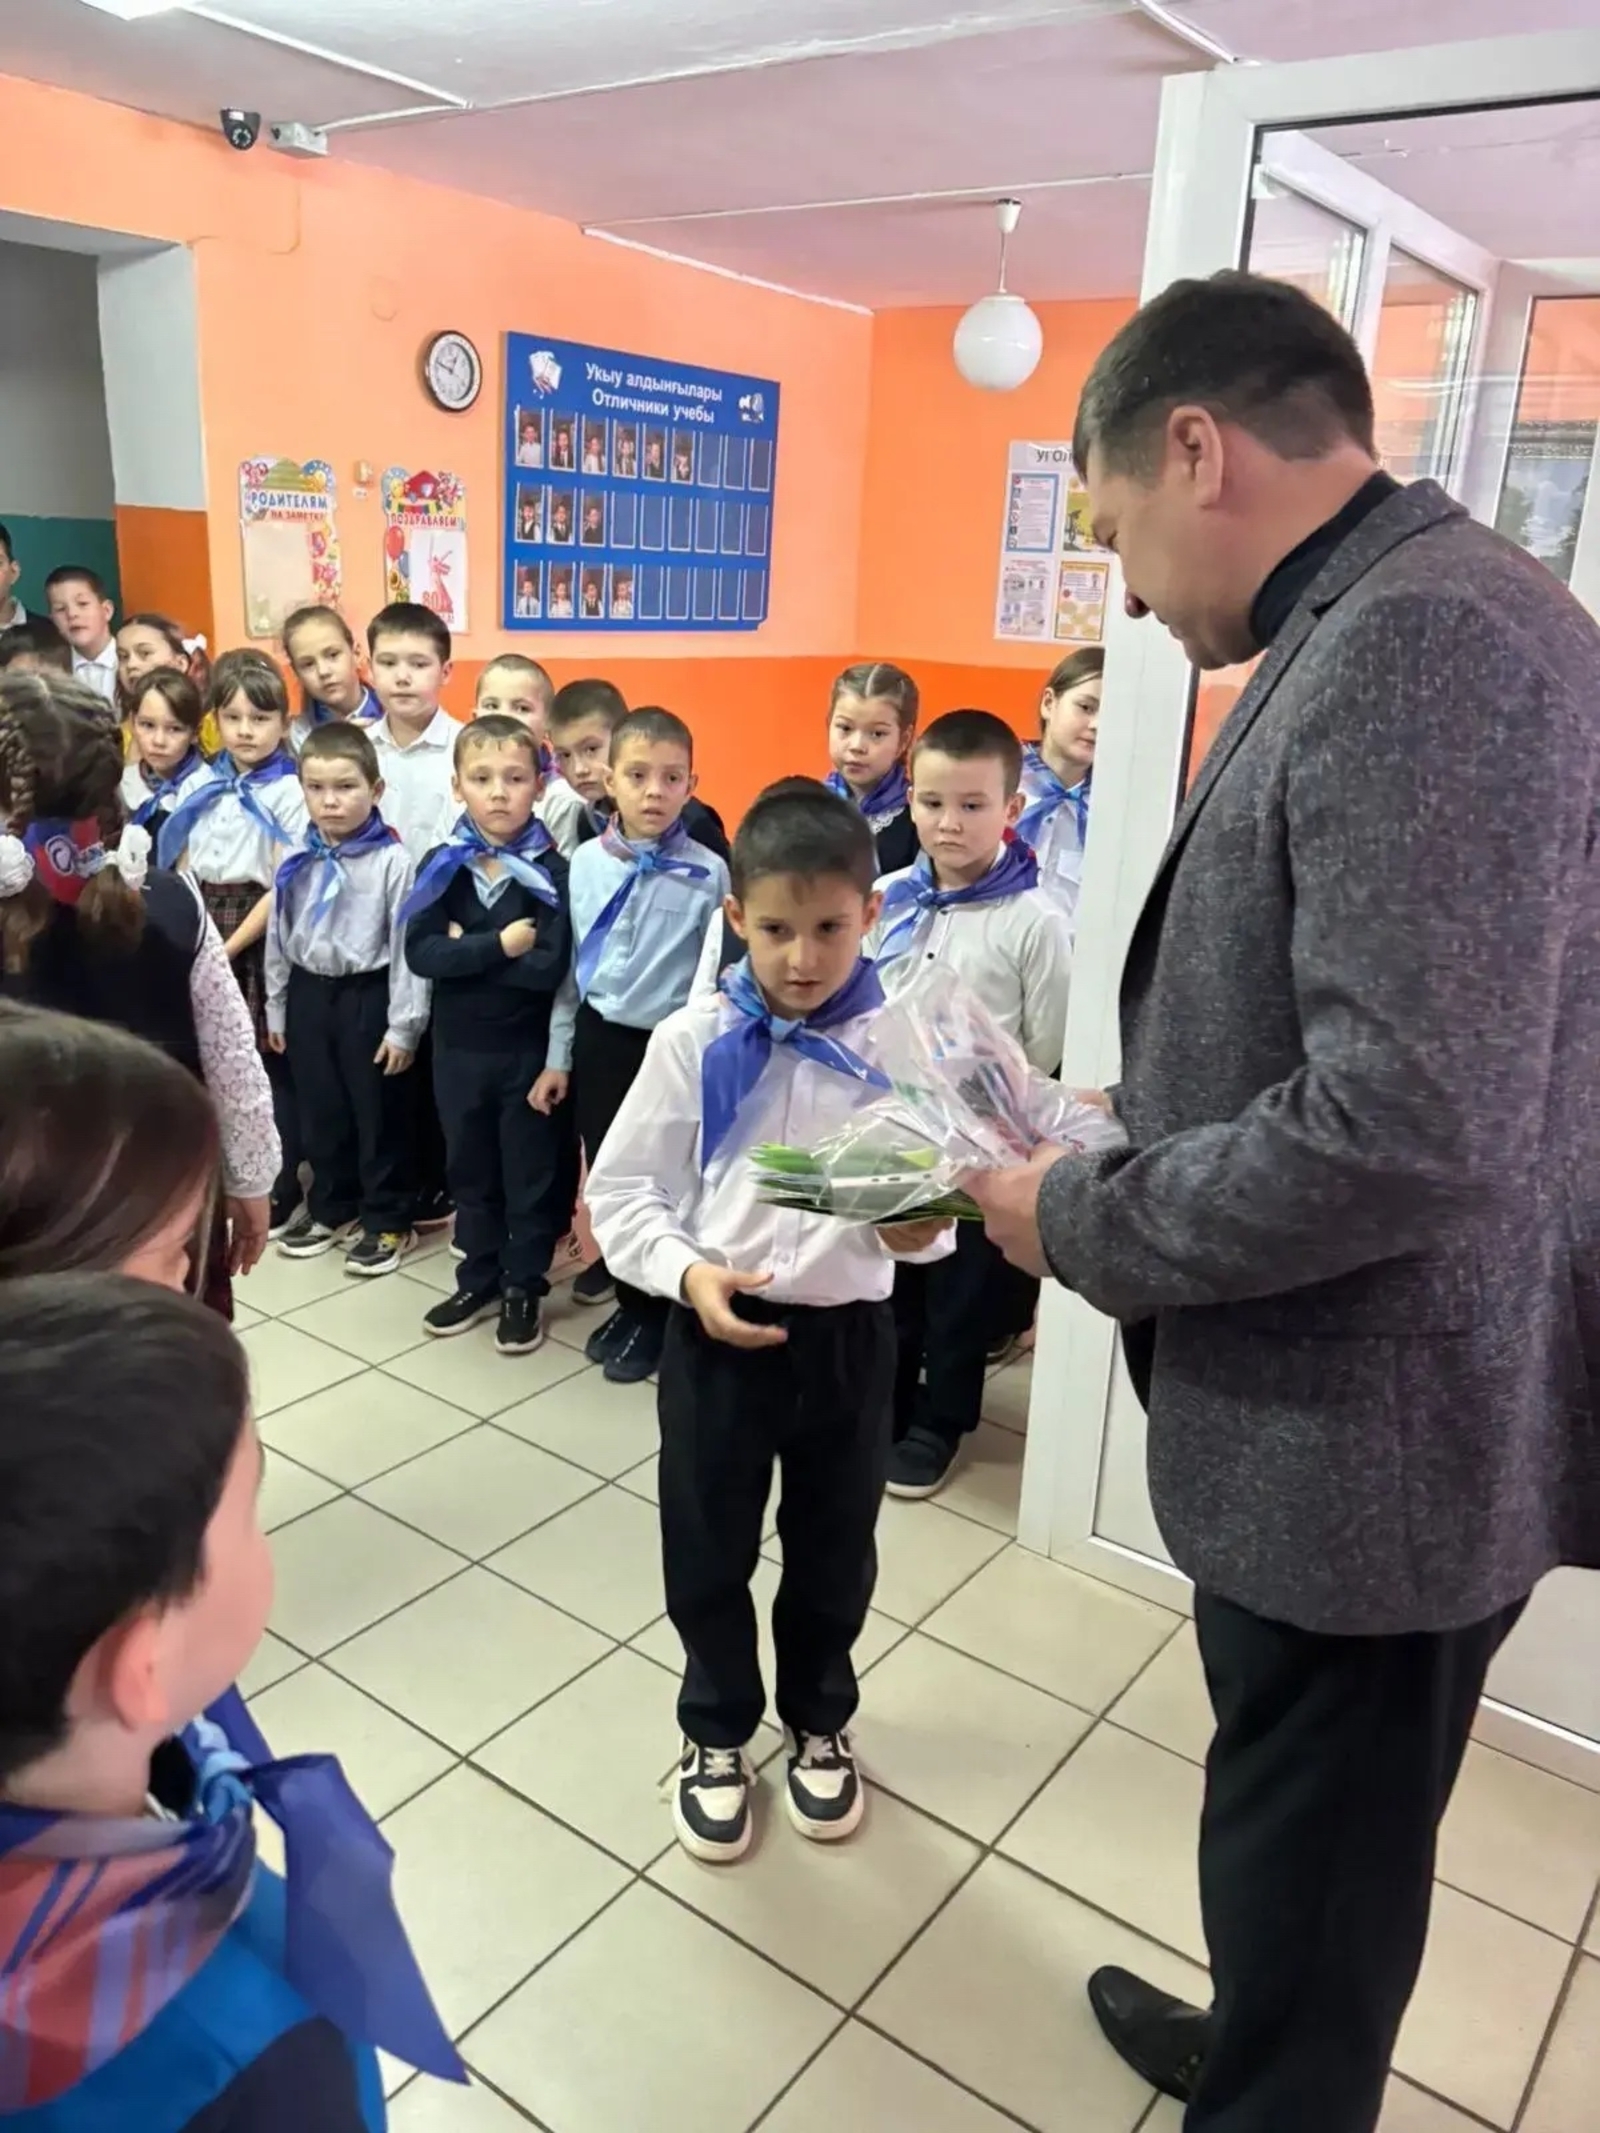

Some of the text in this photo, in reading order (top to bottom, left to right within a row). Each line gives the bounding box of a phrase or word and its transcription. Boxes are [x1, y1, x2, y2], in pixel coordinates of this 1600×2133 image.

[592, 388, 715, 424] Отличники учебы
[251, 491, 328, 509] РОДИТЕЛЯМ
[271, 510, 283, 518] НА
